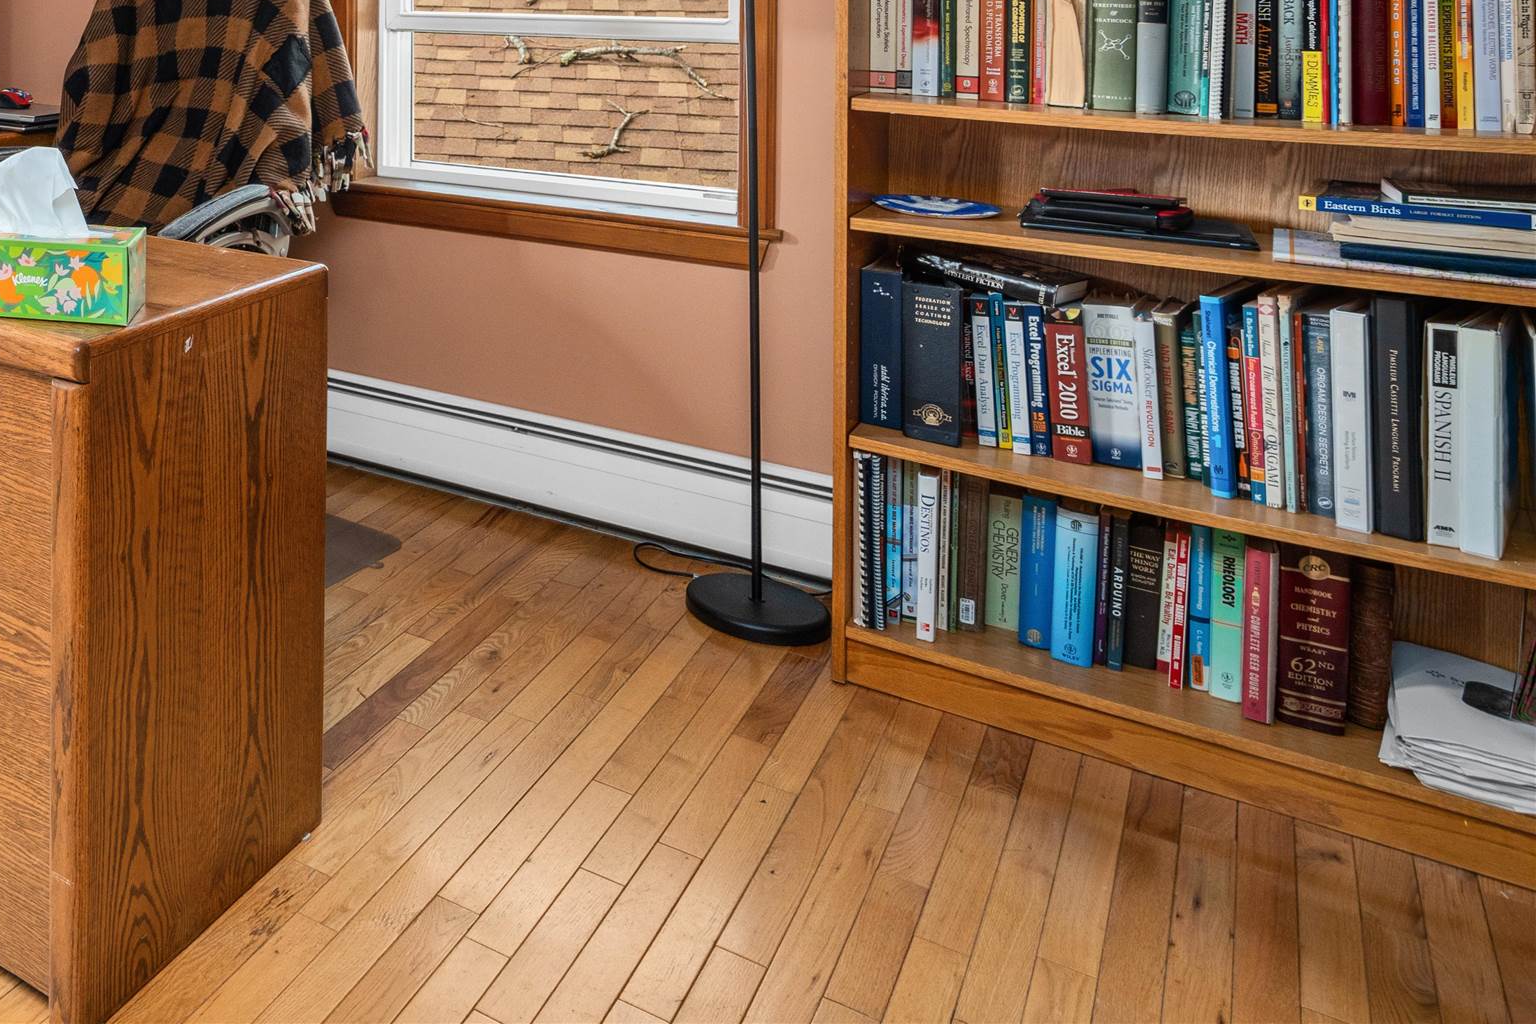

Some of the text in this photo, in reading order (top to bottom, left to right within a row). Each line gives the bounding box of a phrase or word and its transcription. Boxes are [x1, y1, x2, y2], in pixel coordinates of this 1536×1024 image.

[1236, 13, 1248, 45] MATH
[1519, 14, 1530, 39] Physics
[1521, 5, 1530, 13] in
[963, 0, 973, 66] Infrared Spectroscopy
[986, 8, 994, 64] SPECTROMETRY
[995, 14, 1003, 57] TRANSFORM
[1258, 24, 1271, 46] ALL
[1307, 20, 1316, 50] Calculator
[1427, 1, 1437, 70] BACKYARD BALLISTICS
[1258, 47, 1271, 68] THE
[1285, 37, 1294, 92] JASON GOODWIN
[1393, 31, 1401, 85] GIZMOS
[1258, 70, 1271, 94] WAY
[1306, 60, 1318, 107] DUMMIES
[1323, 200, 1366, 213] Eastern
[1371, 204, 1401, 216] Birds
[12, 272, 48, 287] Kleenex
[915, 296, 951, 304] FEDERATION
[944, 269, 1004, 290] MYSTERY FICTION
[915, 311, 951, 319] COATINGS
[915, 317, 950, 327] TECHNOLOGY
[976, 324, 989, 415] Excel Data Analysis
[1028, 315, 1044, 408] Excel Programming
[1089, 347, 1132, 357] IMPLEMENTING
[1090, 356, 1132, 381] SIX
[1010, 332, 1024, 419] Excel Programming
[1056, 333, 1079, 420] Excel 2010
[1091, 379, 1133, 395] SIGMA
[1160, 344, 1174, 434] AND THEY ALL SANG
[1206, 340, 1221, 432] Chemical Demonstrations
[1145, 400, 1155, 447] REVOLUTION
[1229, 362, 1245, 449] HOME BREW BEER
[1263, 365, 1280, 488] The World of ORIGAMI
[1317, 367, 1329, 475] ORIGAMI DESIGN SECRETS
[1389, 349, 1401, 492] PIMSLEUR CASSETTE LANGUAGE PROGRAMS
[1056, 424, 1085, 437] Bible
[1433, 390, 1452, 482] SPANISH II
[920, 494, 936, 553] DESTINOS
[991, 520, 1005, 580] CHEMISTRY
[1005, 527, 1019, 577] GENERAL
[1130, 557, 1159, 568] THINGS
[1132, 564, 1155, 575] WORK
[1304, 563, 1325, 572] CRC
[1112, 566, 1124, 617] ARDUINO
[1222, 555, 1235, 608] RHEOLOGY
[1294, 586, 1333, 600] HANDBOOK
[1290, 602, 1337, 619] CHEMISTRY
[1296, 622, 1331, 636] PHYSICS
[1249, 615, 1261, 699] COMPLETE BEER COURSE
[1288, 671, 1334, 687] EDITION
